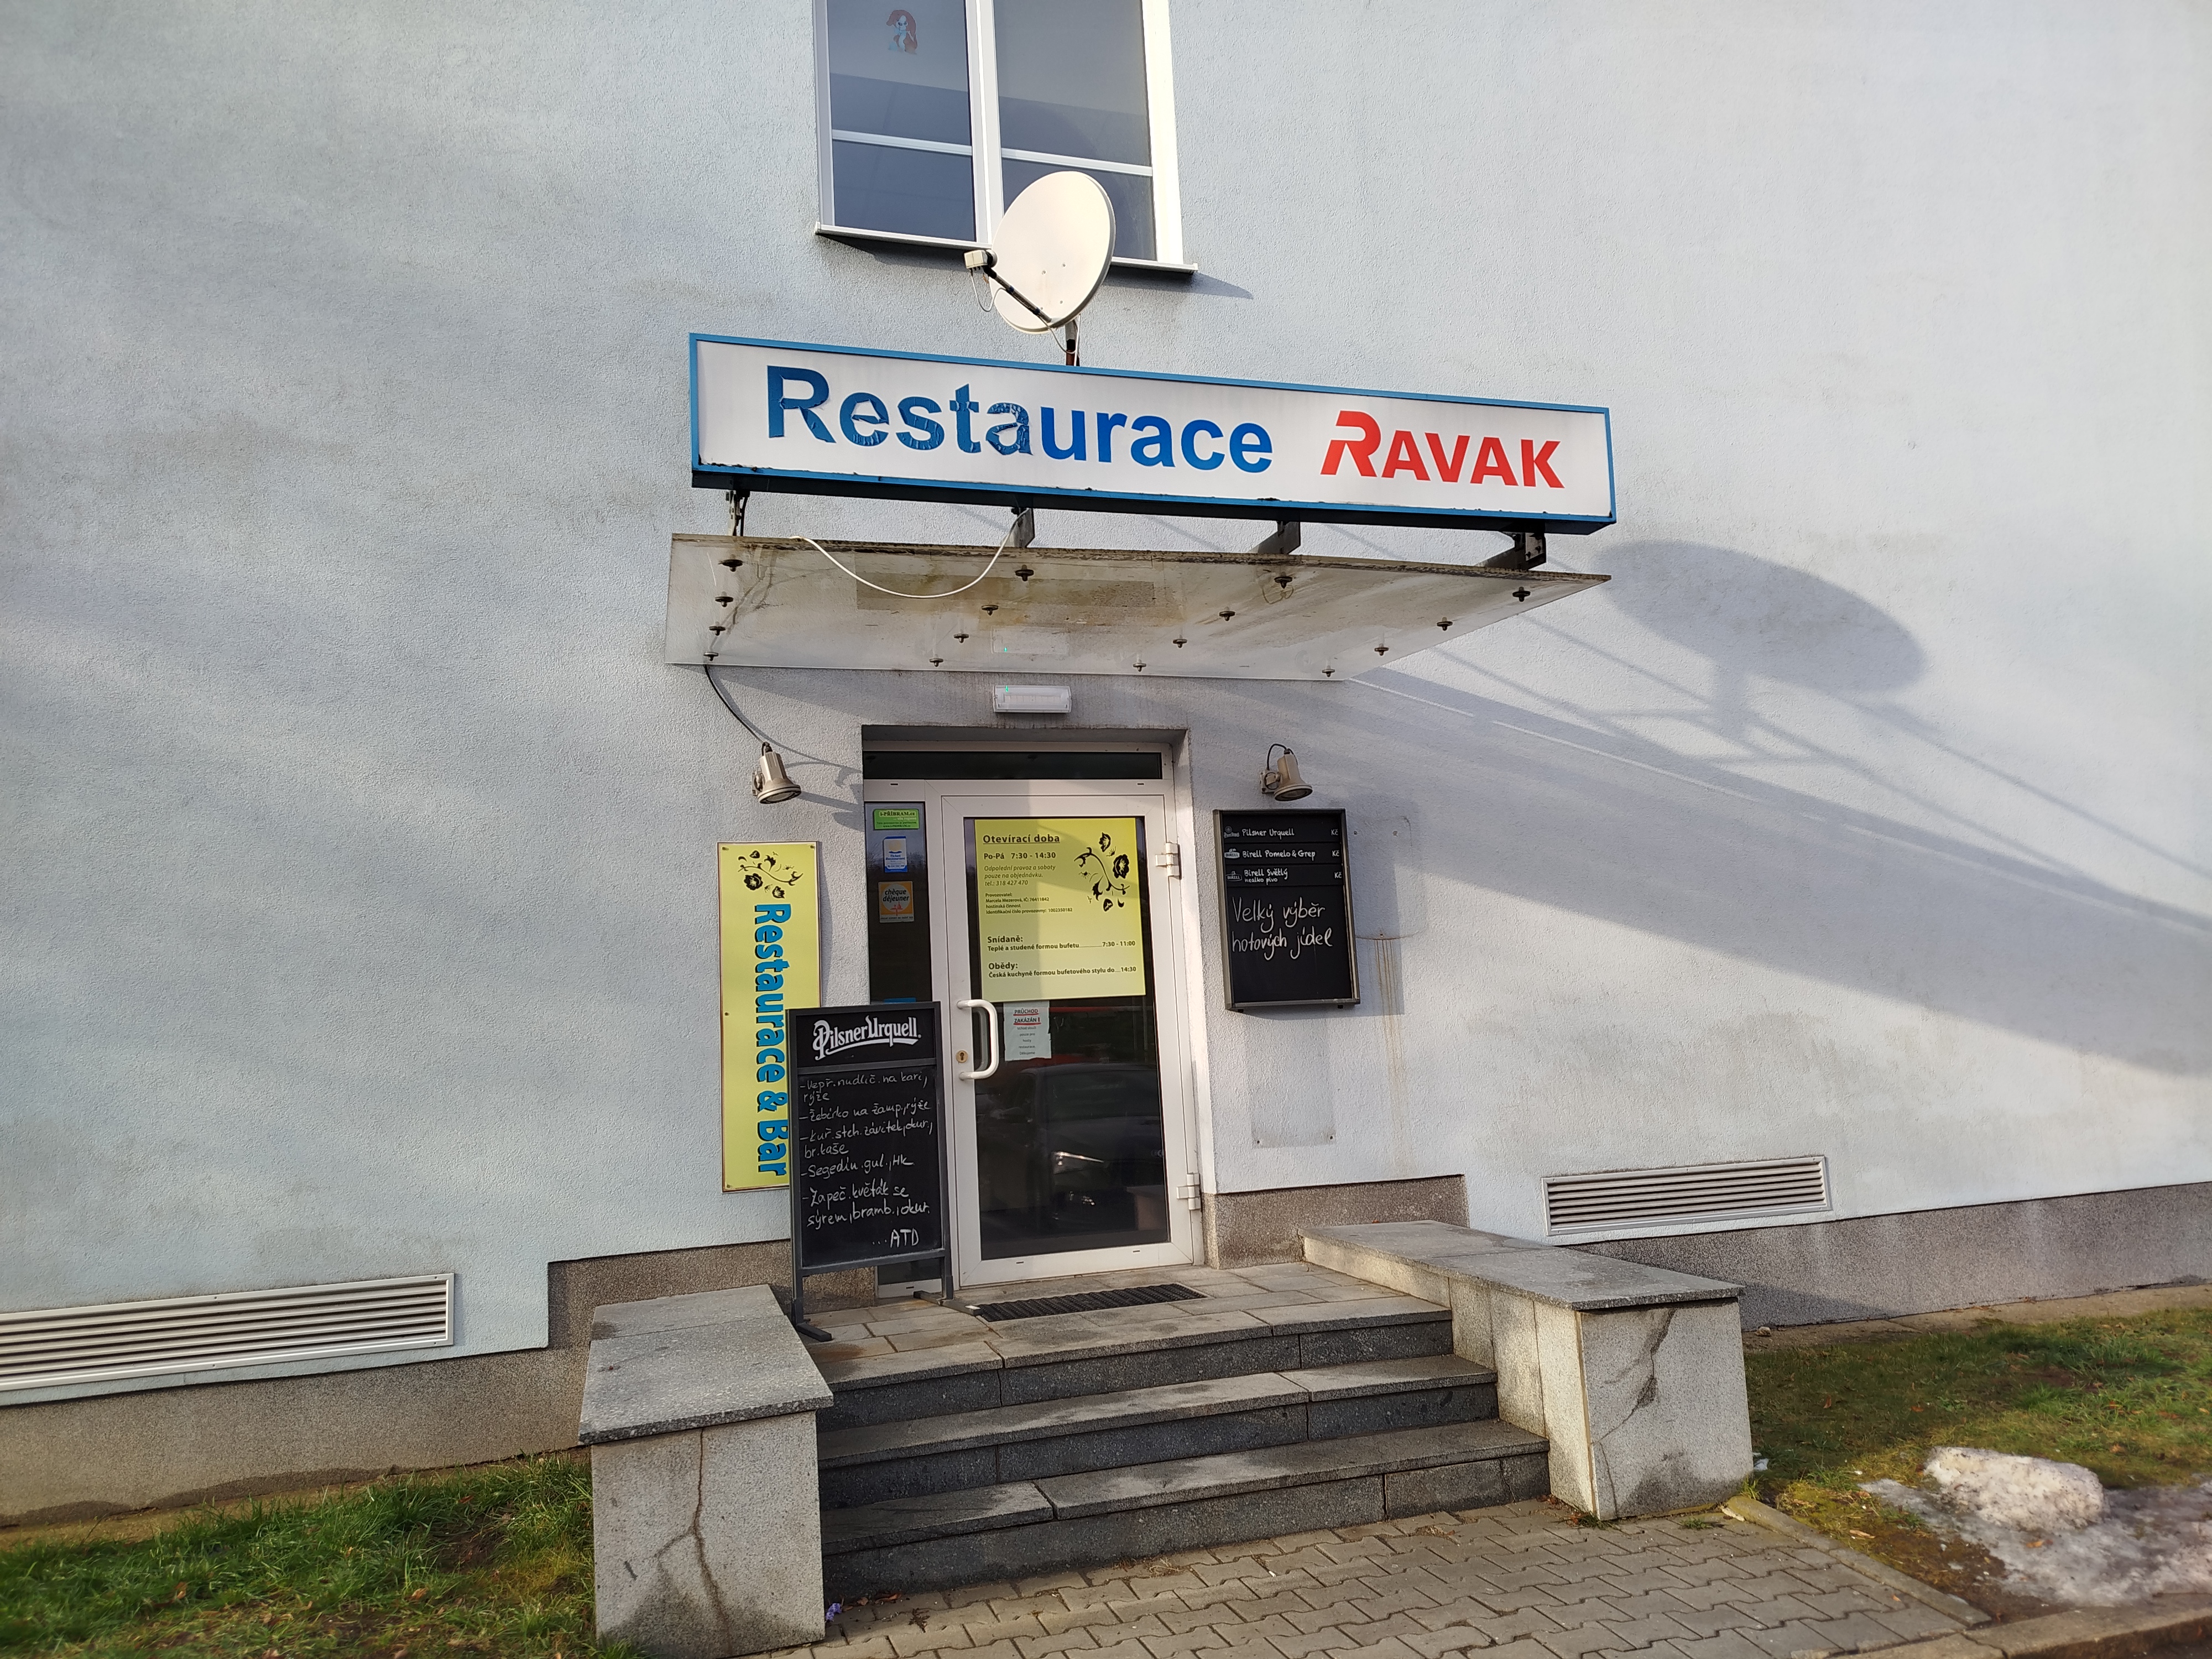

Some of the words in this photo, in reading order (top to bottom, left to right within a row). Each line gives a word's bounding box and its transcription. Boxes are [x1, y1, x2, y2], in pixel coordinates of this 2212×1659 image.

[767, 365, 1273, 473] Restaurace
[1321, 410, 1565, 488] RAVAK
[983, 834, 1031, 843] Otevírací
[1034, 834, 1060, 842] doba
[1242, 828, 1266, 837] Pilsner
[1269, 828, 1295, 840] Urquell
[1297, 850, 1316, 861] Grep
[1266, 868, 1288, 879] Světlý
[1266, 877, 1278, 885] pivo
[1232, 896, 1274, 933] Velký
[1283, 896, 1326, 928] výběr
[1232, 928, 1287, 961] hotových
[1290, 925, 1333, 959] jídel
[988, 962, 1018, 971] Obědy:
[754, 903, 791, 1083] Restaurace
[757, 1092, 788, 1113] &
[804, 1089, 830, 1106] rýže
[854, 1108, 868, 1117] na
[757, 1119, 789, 1176] Bar
[893, 1186, 909, 1197] se
